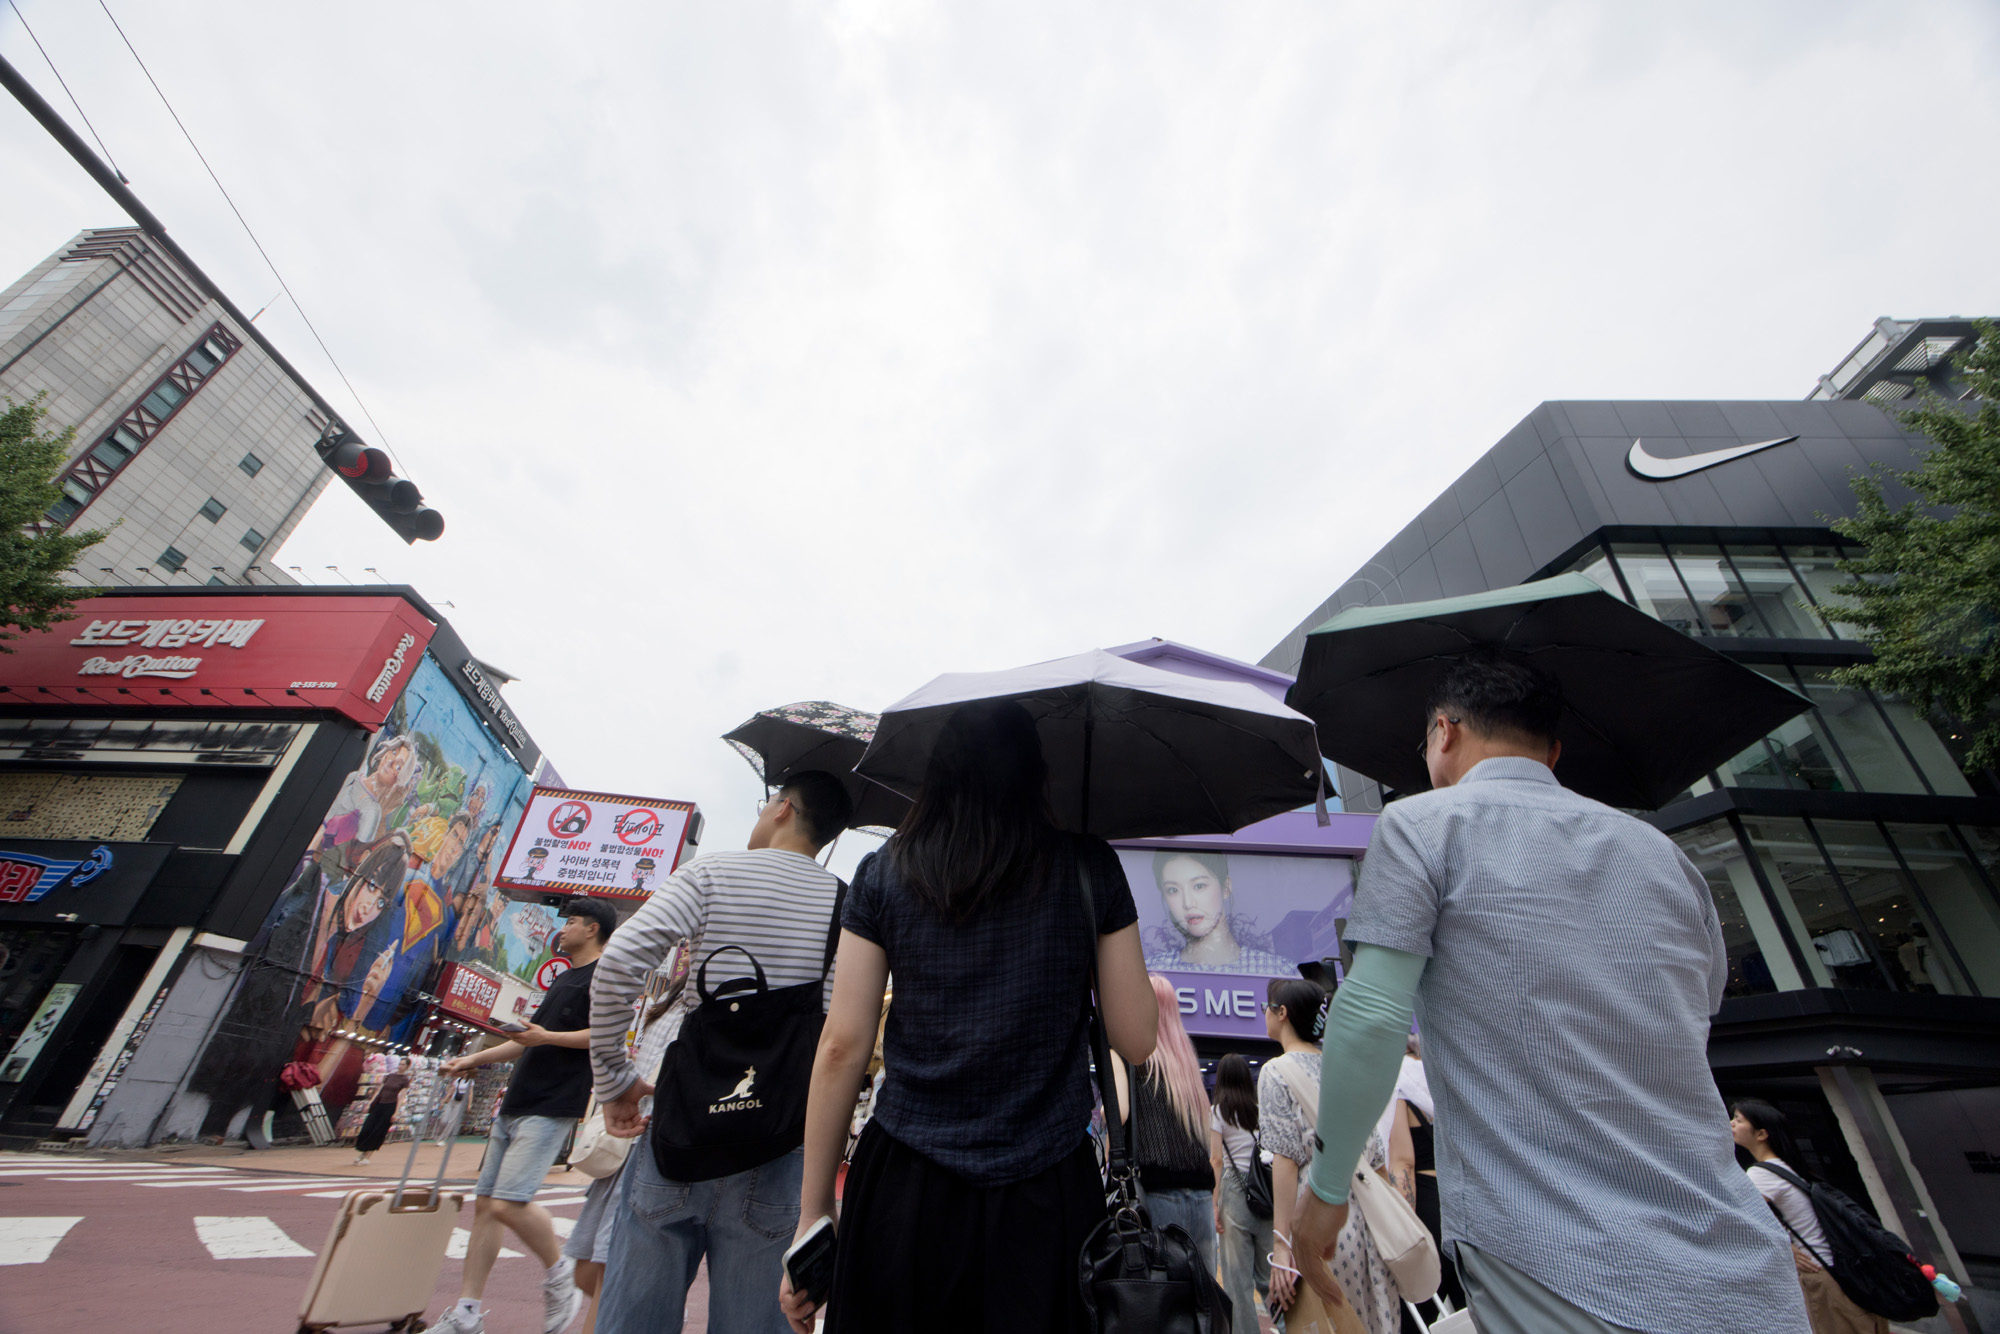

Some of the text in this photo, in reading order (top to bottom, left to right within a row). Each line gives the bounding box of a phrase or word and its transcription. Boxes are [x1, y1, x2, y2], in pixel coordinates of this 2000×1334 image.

[69, 619, 266, 648] 보드게임카페
[462, 659, 503, 715] 보드게임카페
[612, 814, 665, 836] 딥페이크
[559, 854, 621, 871] 사이버 성폭력
[557, 867, 617, 883] 중범죄입니다
[708, 1099, 763, 1114] KANGOL
